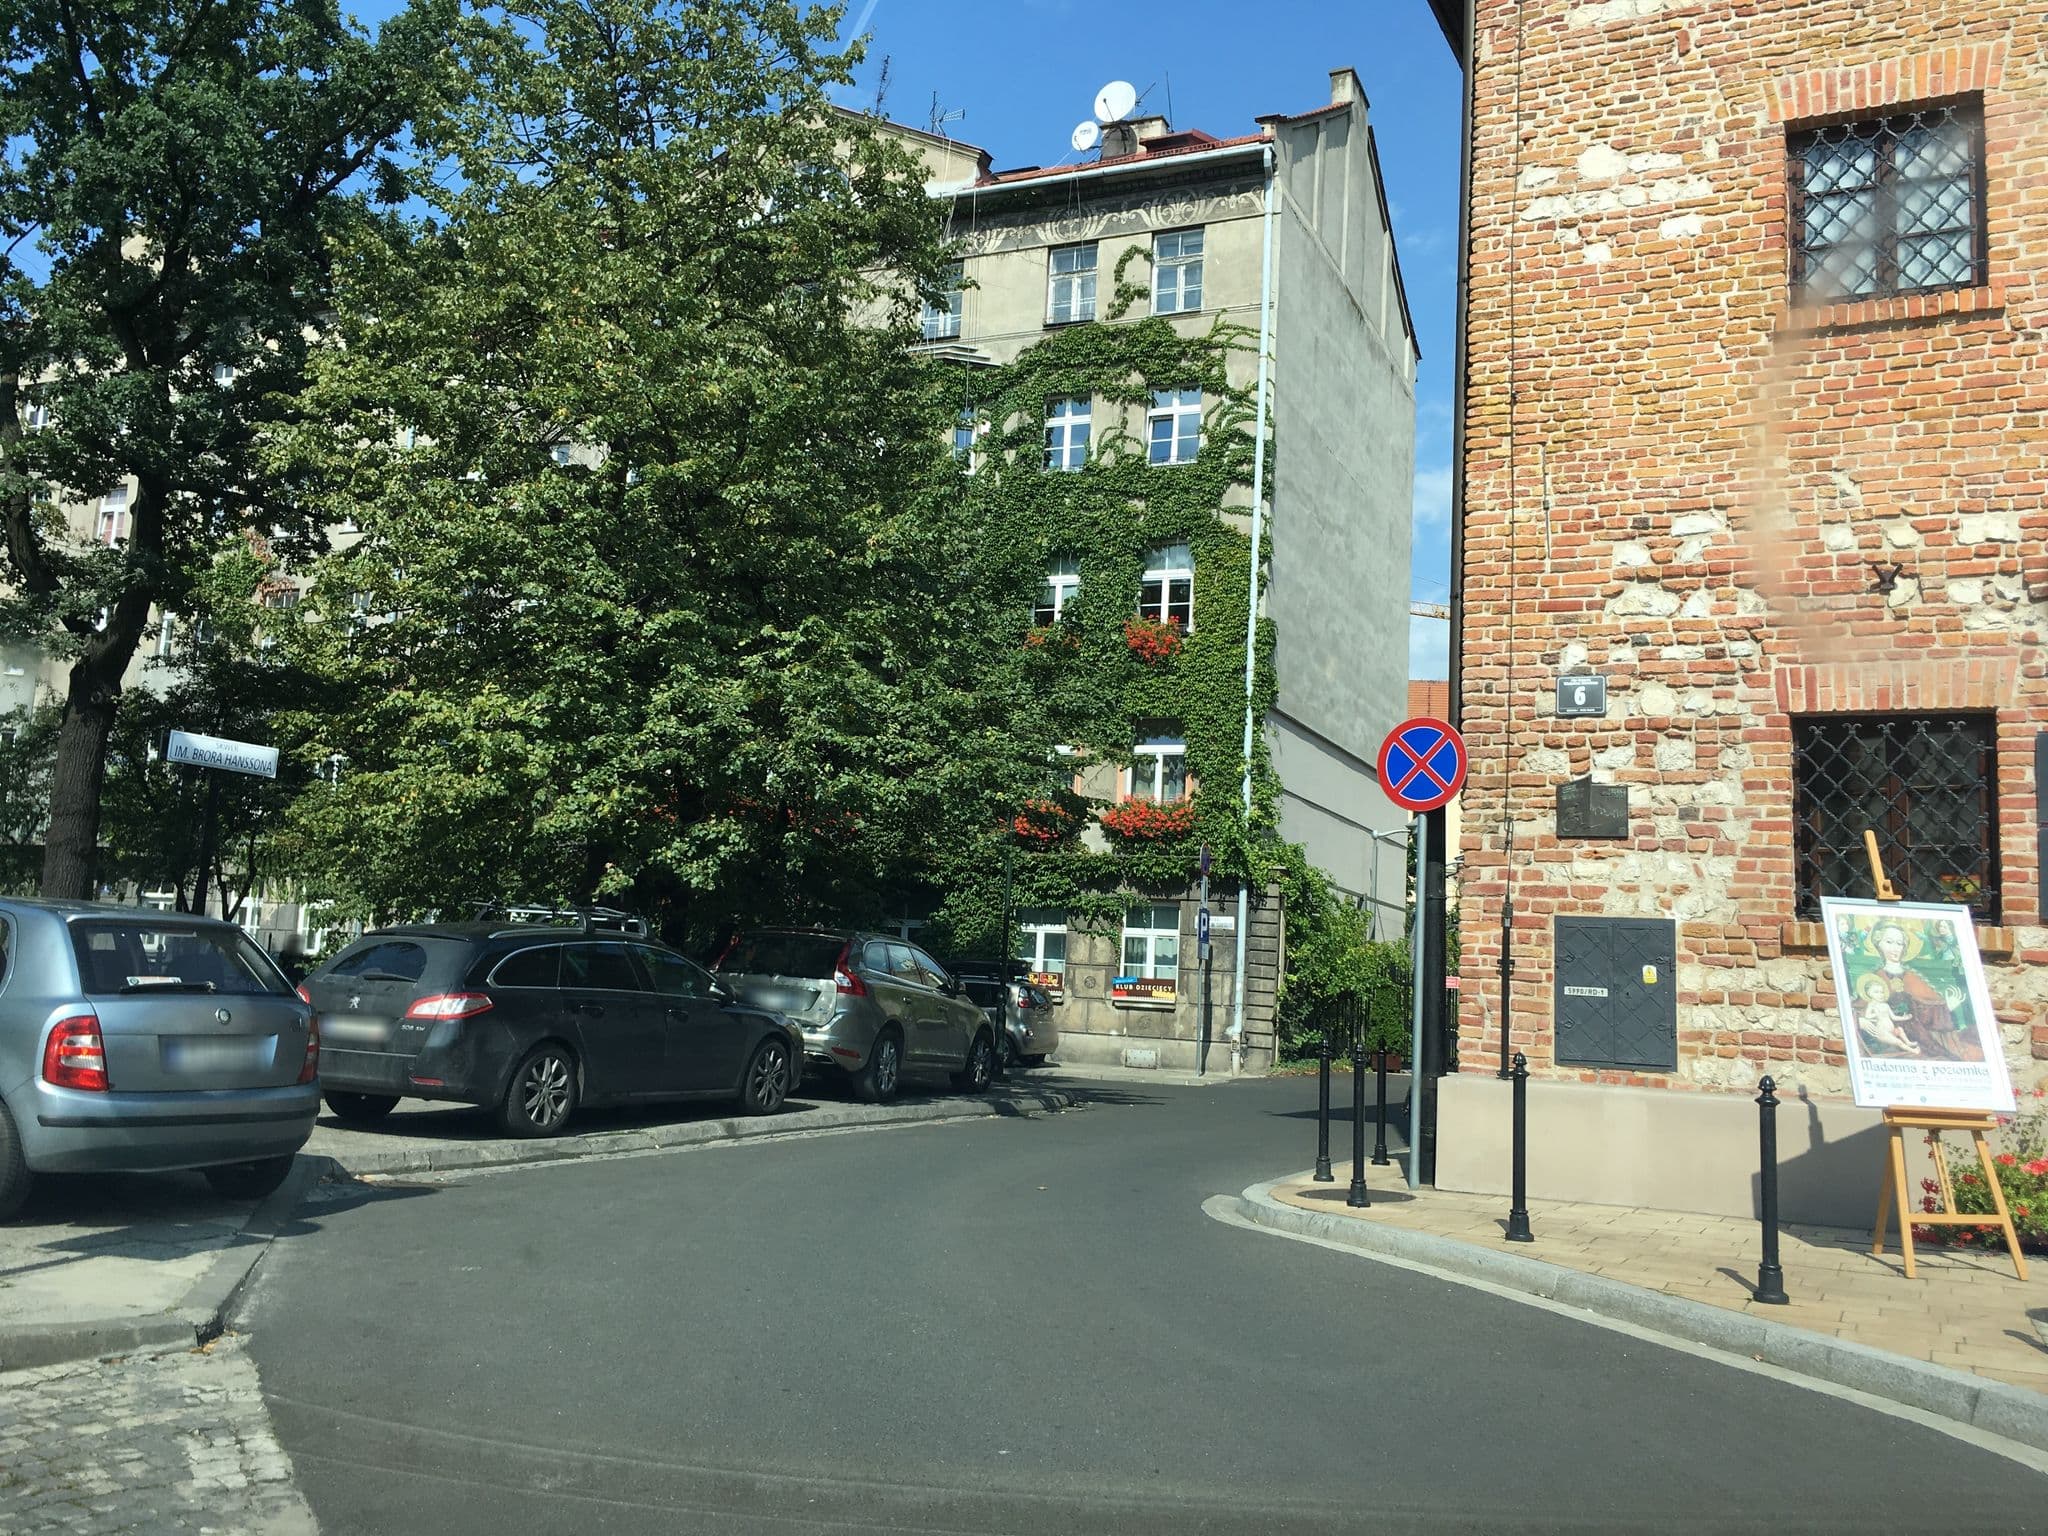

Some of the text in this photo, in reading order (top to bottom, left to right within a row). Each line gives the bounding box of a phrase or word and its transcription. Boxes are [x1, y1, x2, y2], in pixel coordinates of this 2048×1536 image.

[1574, 686, 1586, 705] 6
[174, 744, 272, 773] IM. BRORA HANSSONA
[1200, 912, 1208, 938] P
[1861, 1059, 1917, 1073] Madonna
